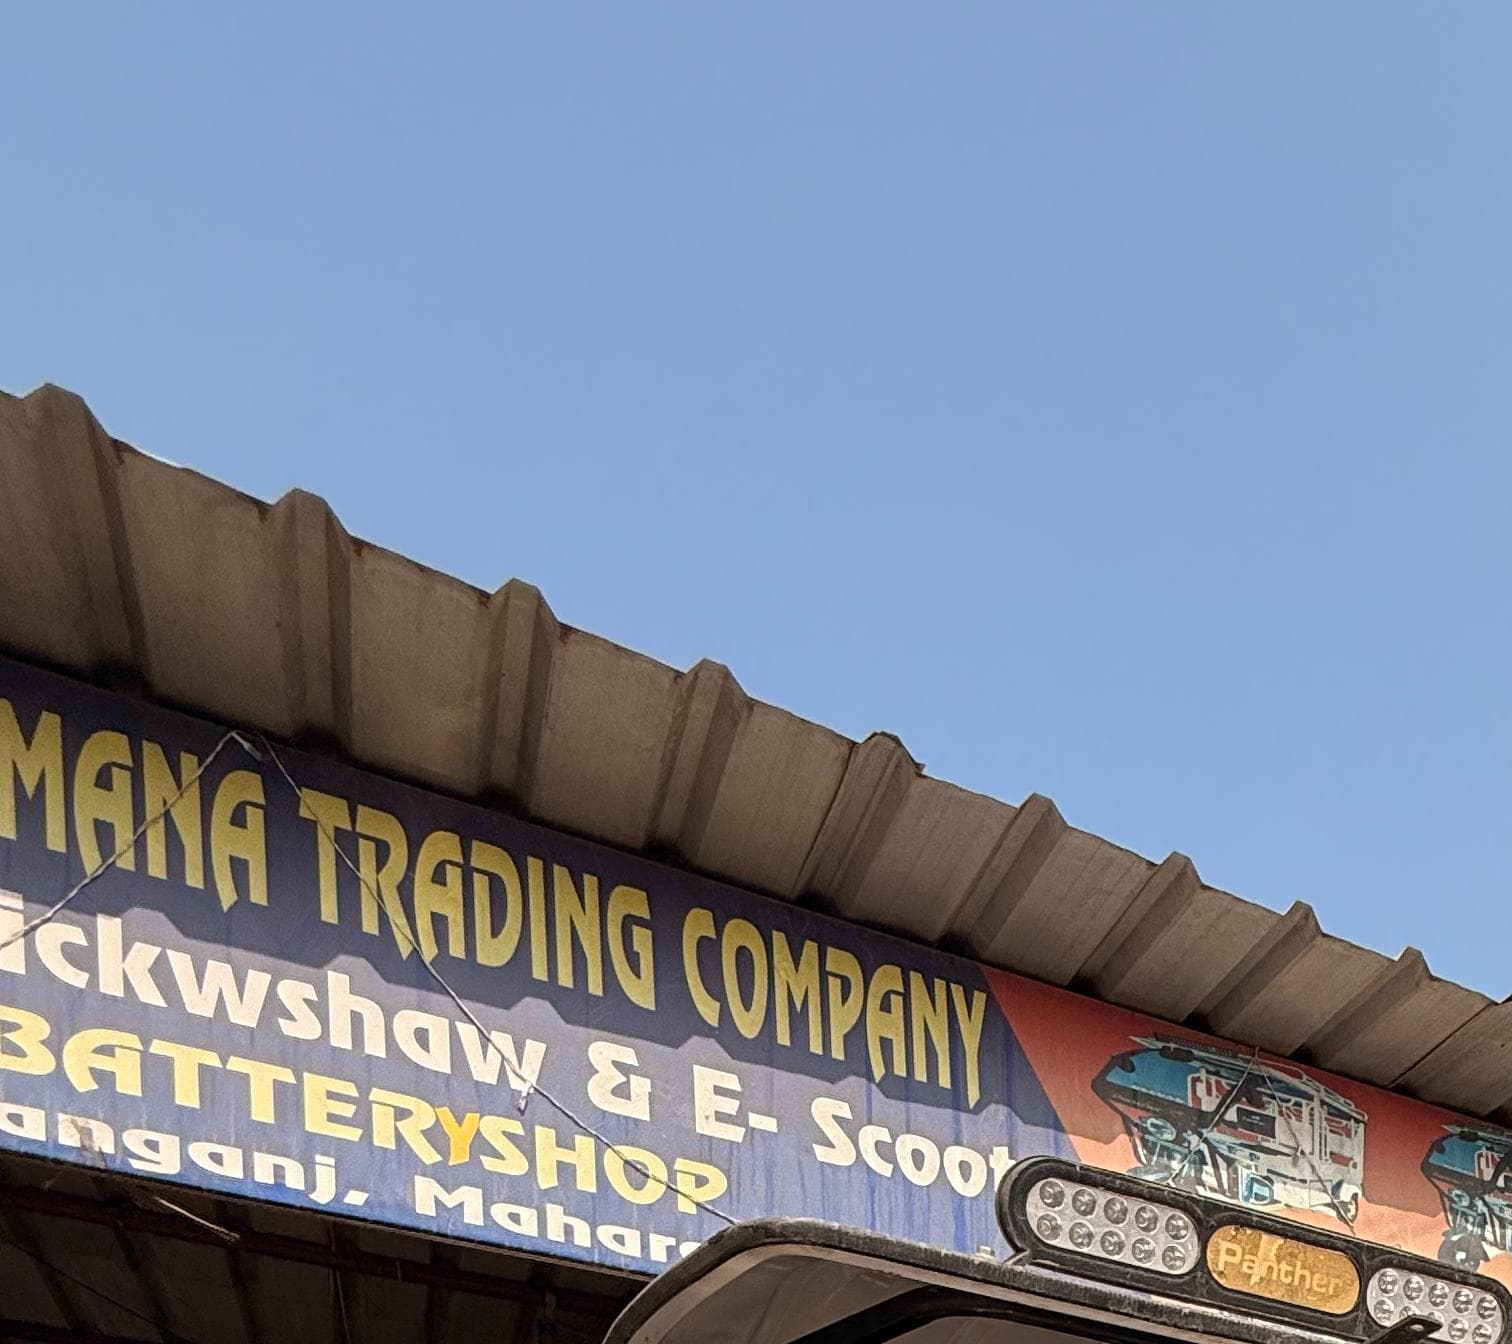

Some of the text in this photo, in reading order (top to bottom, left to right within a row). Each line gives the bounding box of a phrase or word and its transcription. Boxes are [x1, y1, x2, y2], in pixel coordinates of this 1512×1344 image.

[0, 697, 987, 1109] MANA TRADING COMPANY
[0, 889, 547, 1092] ickwshaw
[588, 1041, 651, 1121] &
[692, 1065, 777, 1143] E-
[1216, 1238, 1343, 1297] Panther
